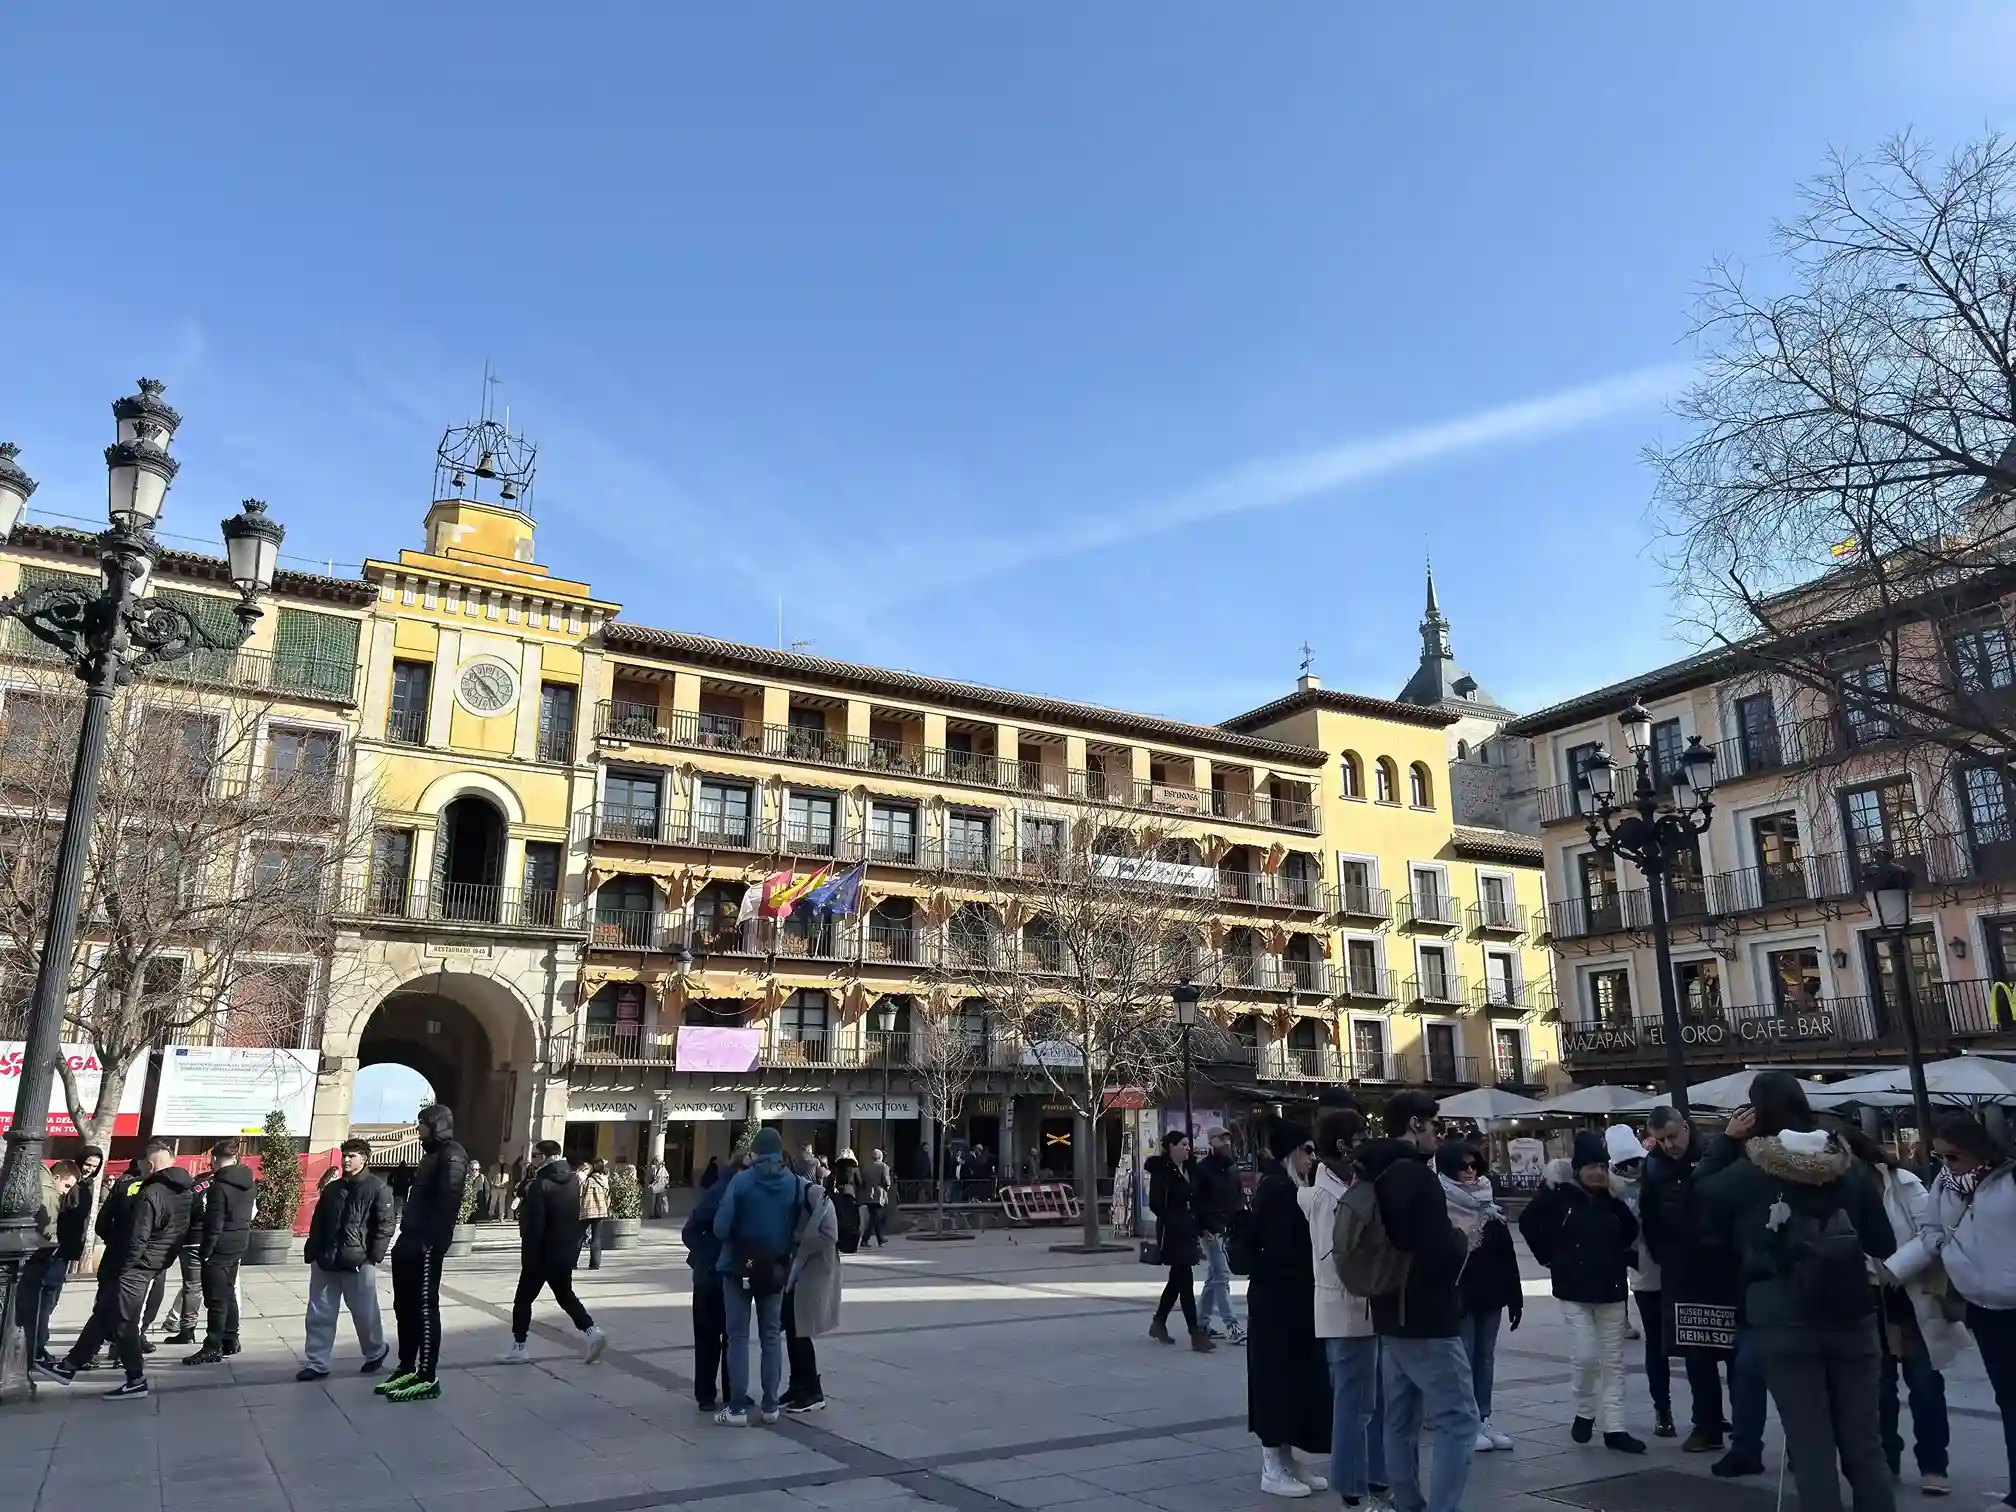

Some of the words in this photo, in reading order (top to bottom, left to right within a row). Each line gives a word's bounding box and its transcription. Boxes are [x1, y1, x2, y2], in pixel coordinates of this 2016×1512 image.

[1563, 1031, 1637, 1051] MAZAPAN
[1650, 1027, 1667, 1045] EL
[1681, 1024, 1723, 1044] ORO
[582, 1102, 638, 1112] MAZAPAN
[673, 1102, 708, 1112] SANTO
[769, 1102, 825, 1112] CONFITERIA
[855, 1102, 883, 1111] SANTO
[1680, 1330, 1711, 1342] REINA
